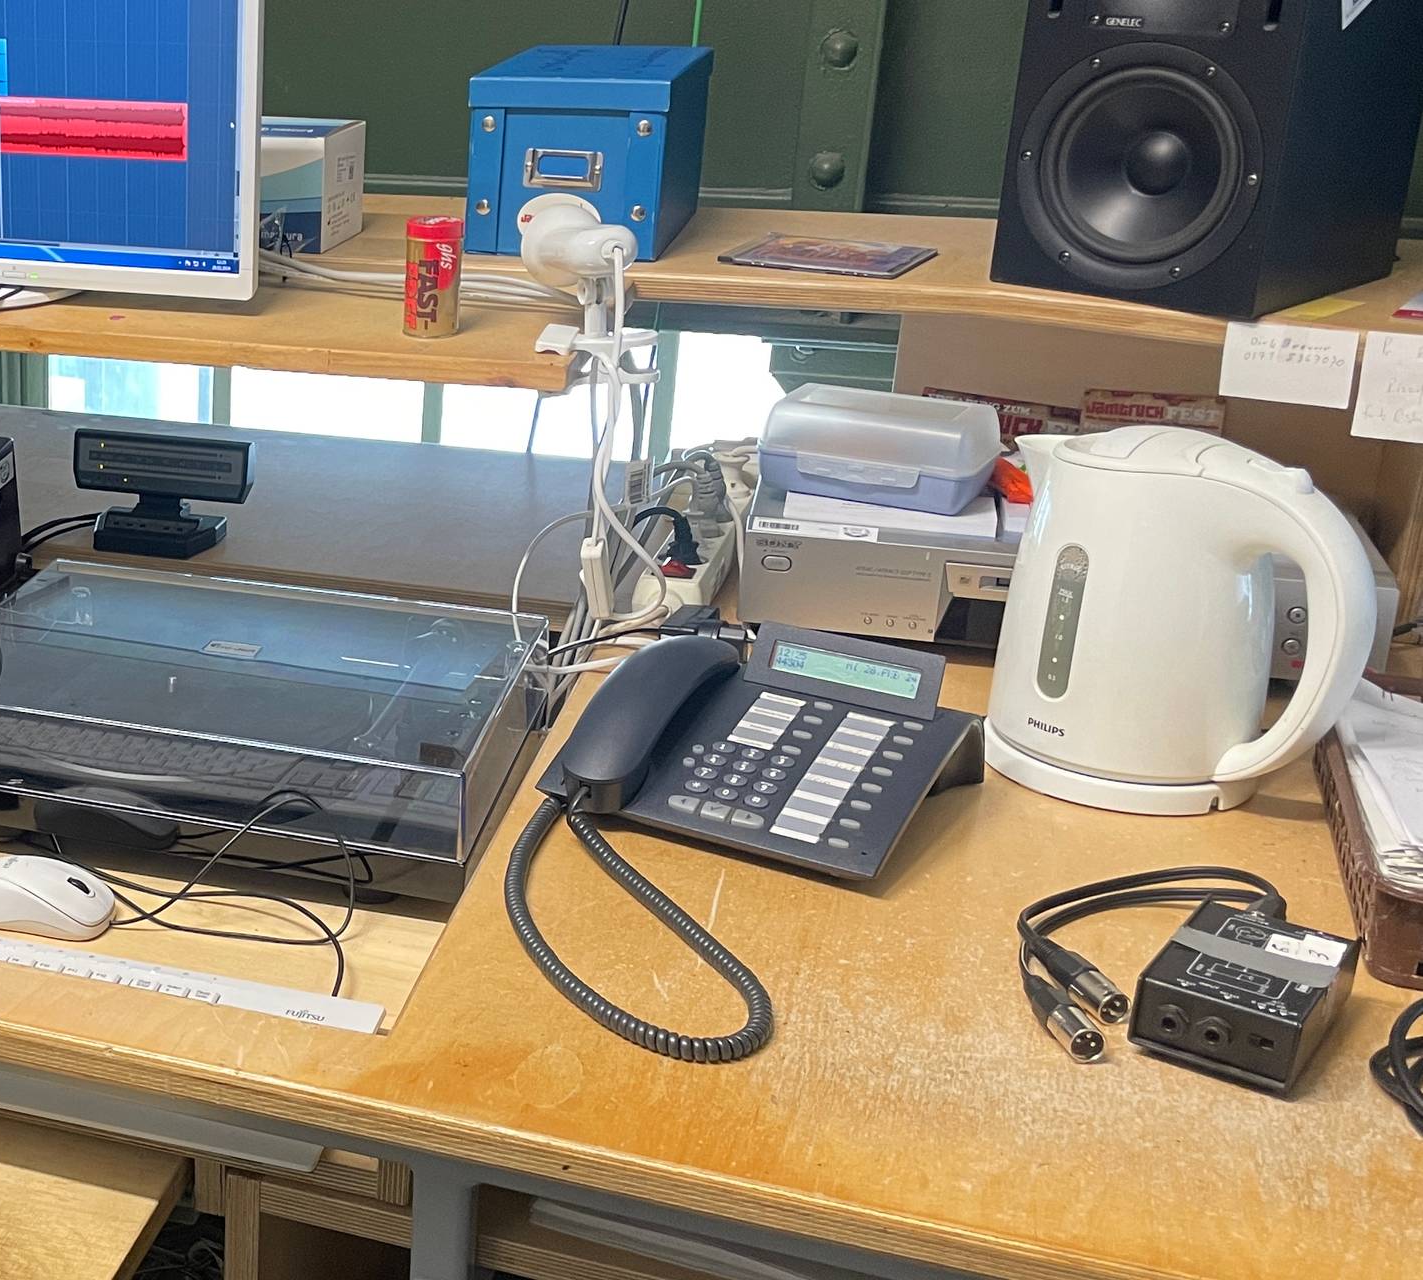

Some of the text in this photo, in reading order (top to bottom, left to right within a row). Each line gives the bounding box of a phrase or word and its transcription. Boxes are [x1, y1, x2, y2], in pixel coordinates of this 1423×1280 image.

[1105, 18, 1143, 27] GENELEC
[436, 242, 457, 270] ghs
[1027, 716, 1066, 737] PHILIPS
[285, 1009, 325, 1022] FUJITSU
